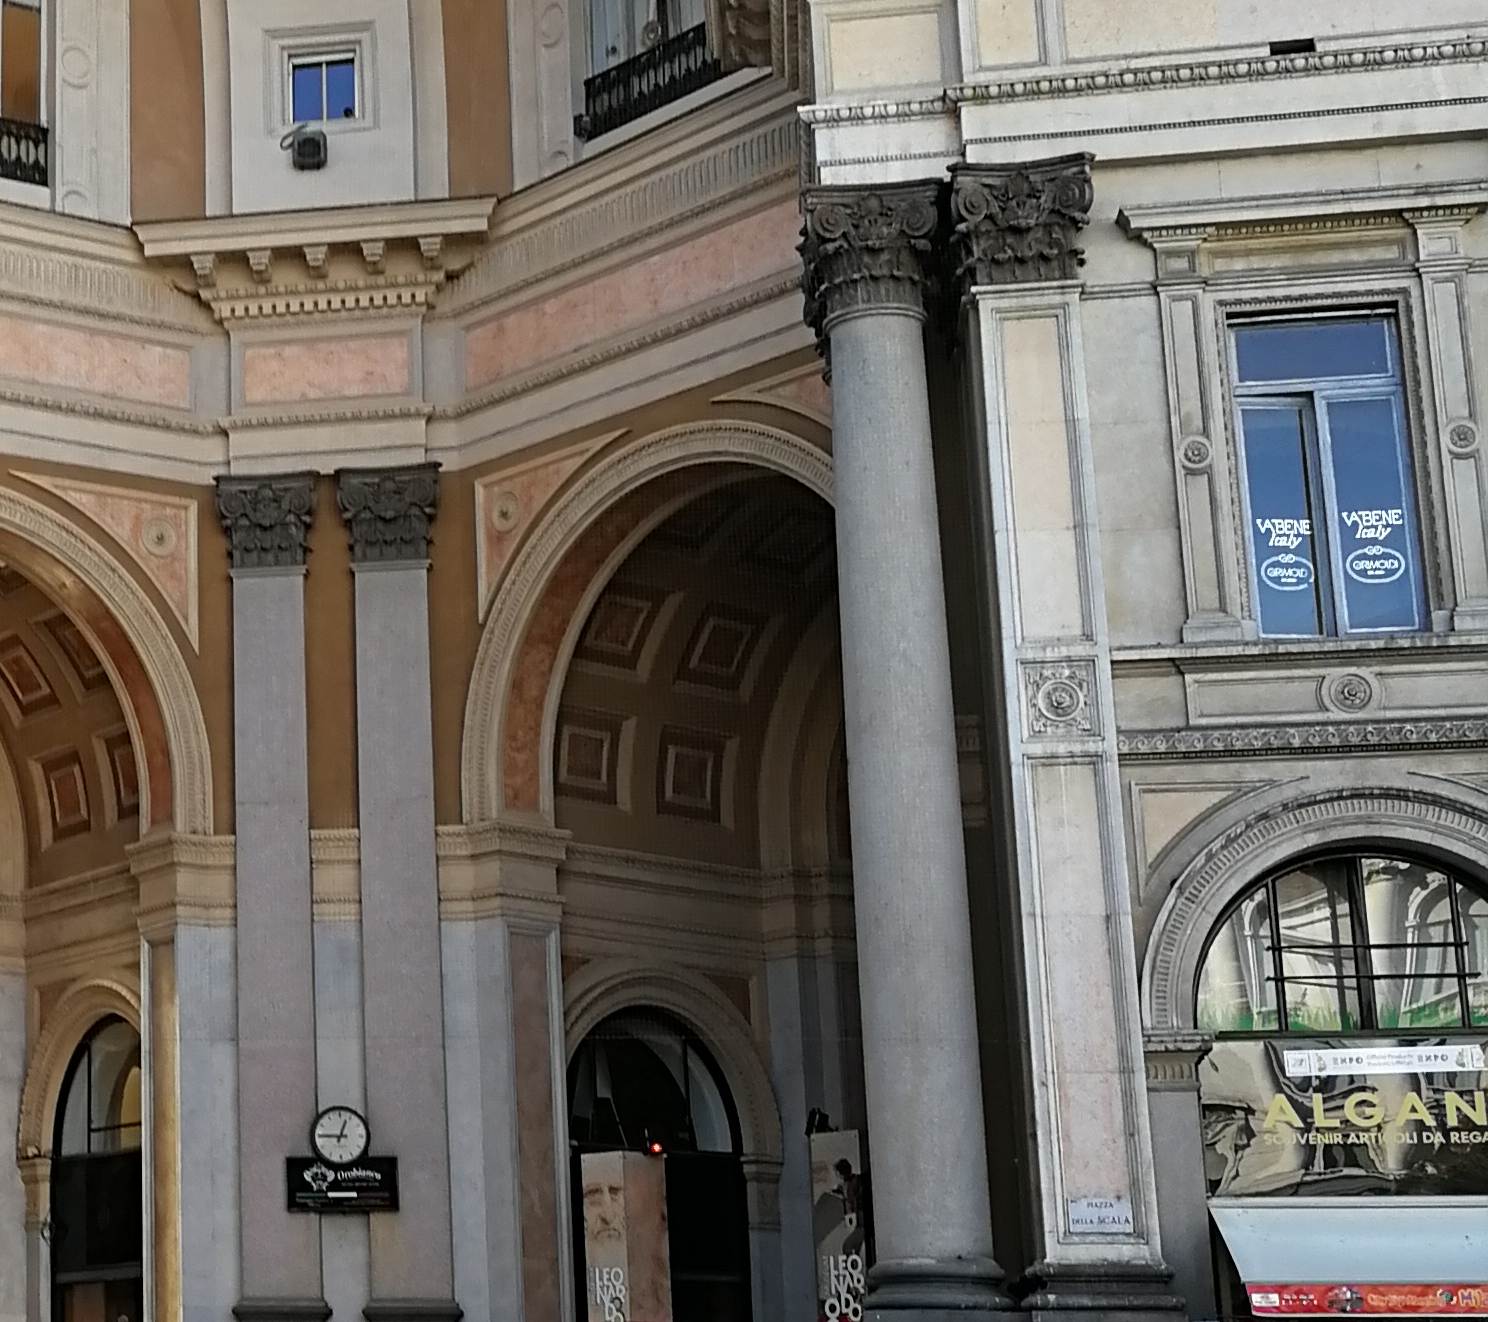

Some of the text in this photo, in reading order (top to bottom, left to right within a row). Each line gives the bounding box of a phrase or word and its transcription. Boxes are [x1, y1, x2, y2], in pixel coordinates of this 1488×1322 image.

[1355, 524, 1392, 540] Italy
[1268, 532, 1303, 549] Italy
[1332, 1054, 1363, 1065] EXPO
[1417, 1053, 1449, 1063] EXPO
[1263, 1091, 1488, 1128] ALGAN
[1264, 1131, 1343, 1146] SOUVENIR
[1347, 1130, 1418, 1145] ARTICOLI
[1422, 1130, 1446, 1145] DA
[1097, 1215, 1131, 1225] SCALA
